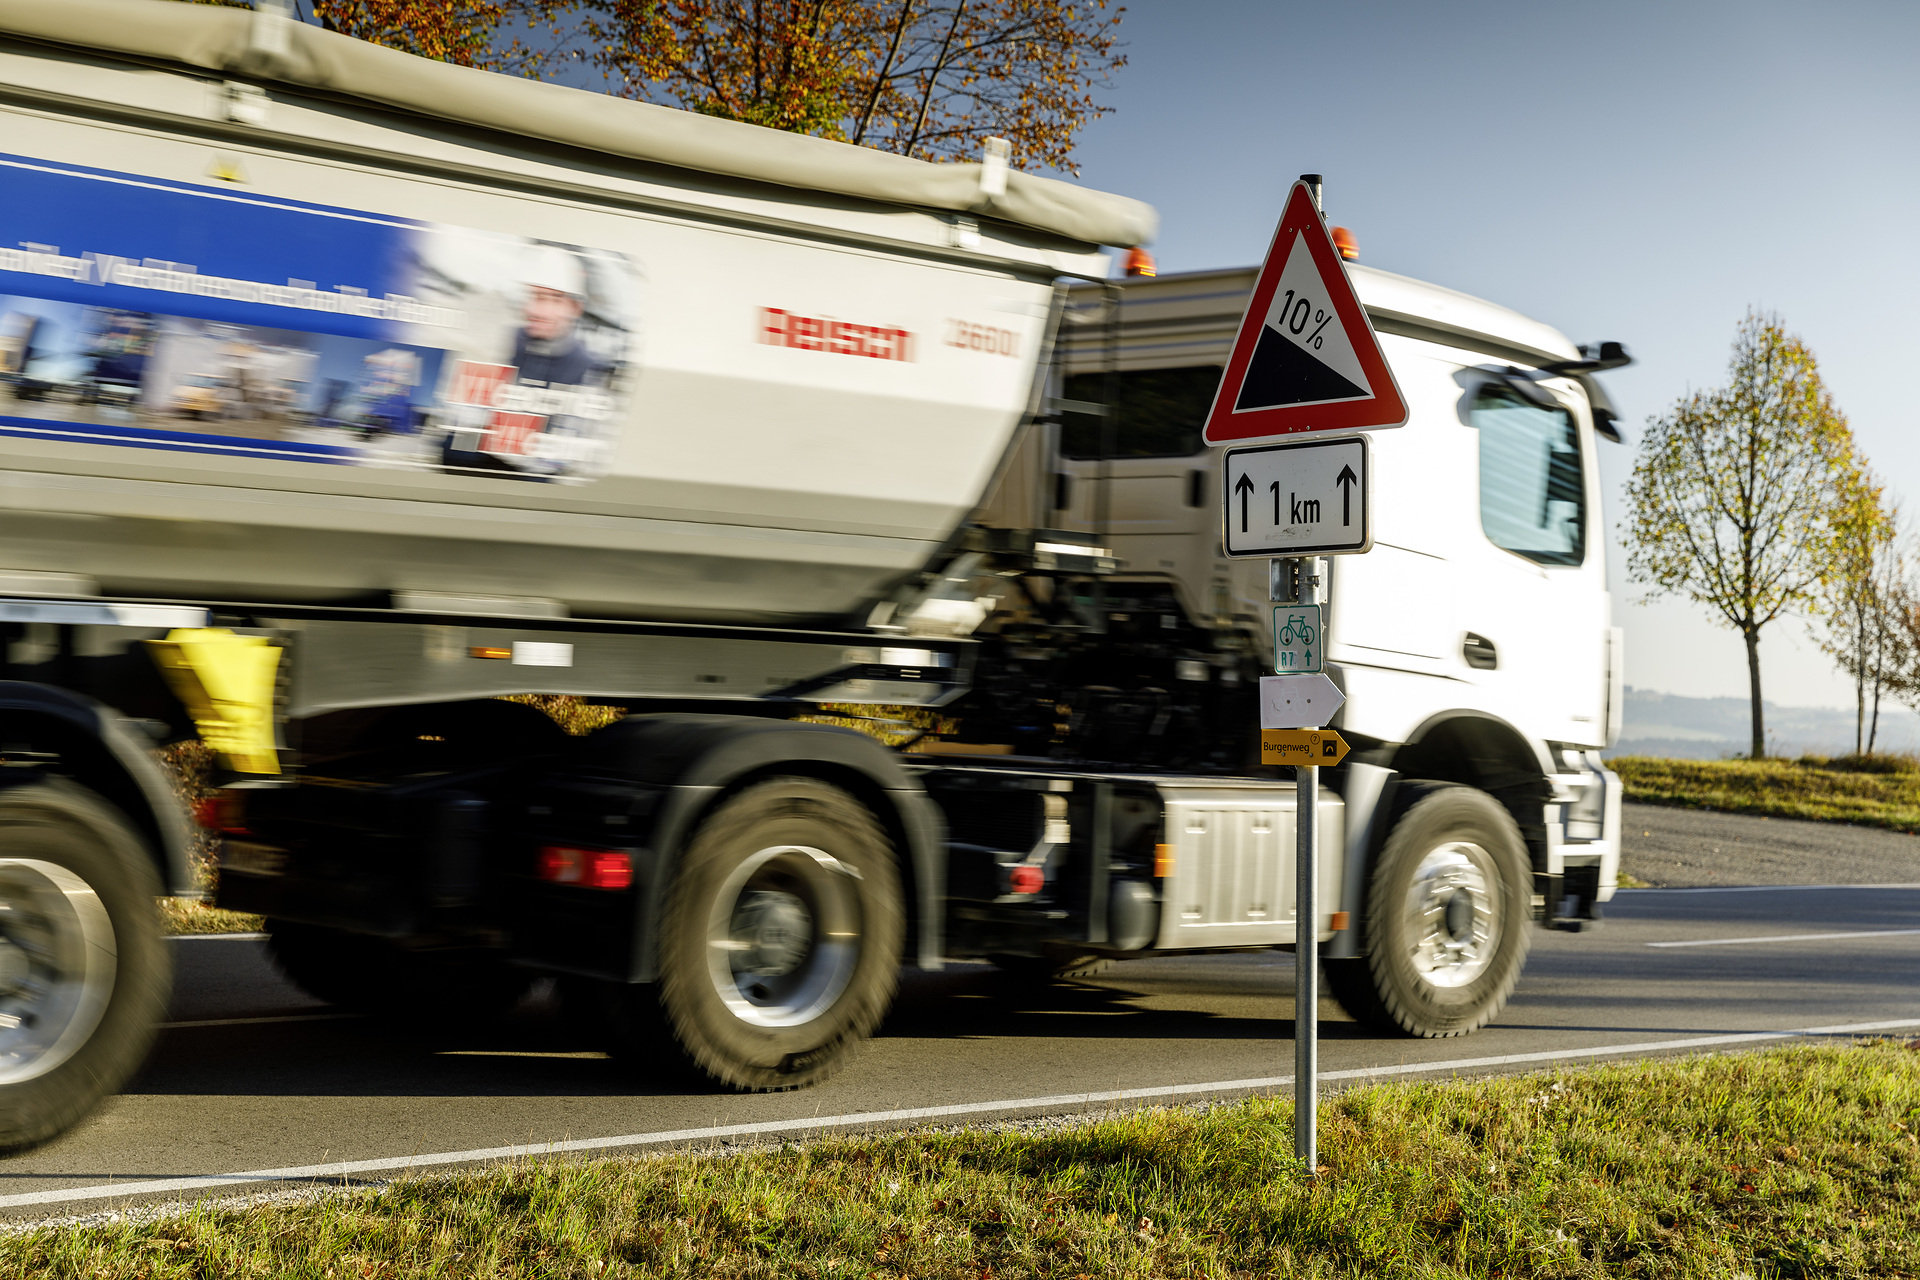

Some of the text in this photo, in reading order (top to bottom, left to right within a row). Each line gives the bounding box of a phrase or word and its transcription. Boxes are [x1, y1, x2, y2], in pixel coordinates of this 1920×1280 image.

[1278, 289, 1333, 350] 10%
[1269, 480, 1321, 526] 1 km
[1263, 741, 1310, 754] Burgenweg
